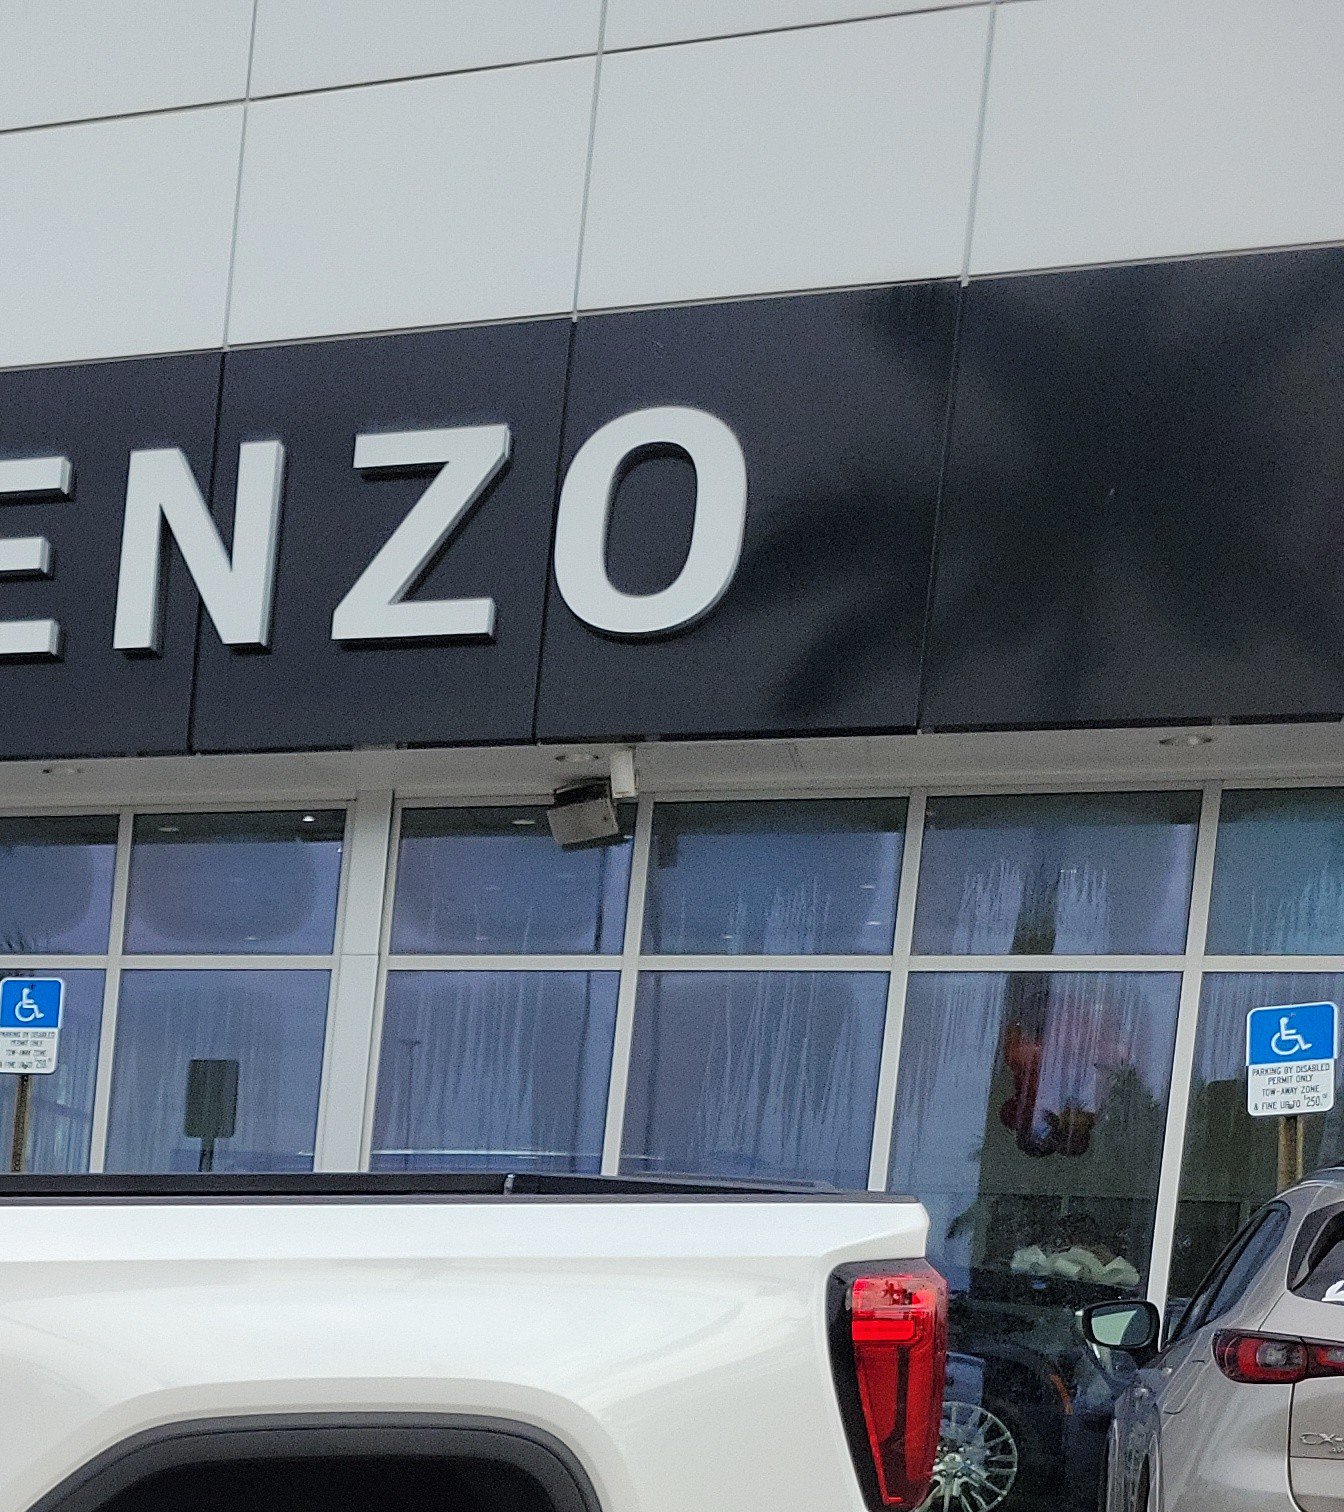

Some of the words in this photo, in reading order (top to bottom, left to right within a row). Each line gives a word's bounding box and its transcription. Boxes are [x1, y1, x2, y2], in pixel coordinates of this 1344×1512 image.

[1252, 1067, 1282, 1077] PARKING
[1296, 1063, 1330, 1074] DISABLED
[1267, 1076, 1293, 1085] PERMIT
[1296, 1074, 1314, 1083] ONLY
[1301, 1084, 1320, 1094] ZONE
[1262, 1101, 1278, 1110] FINE
